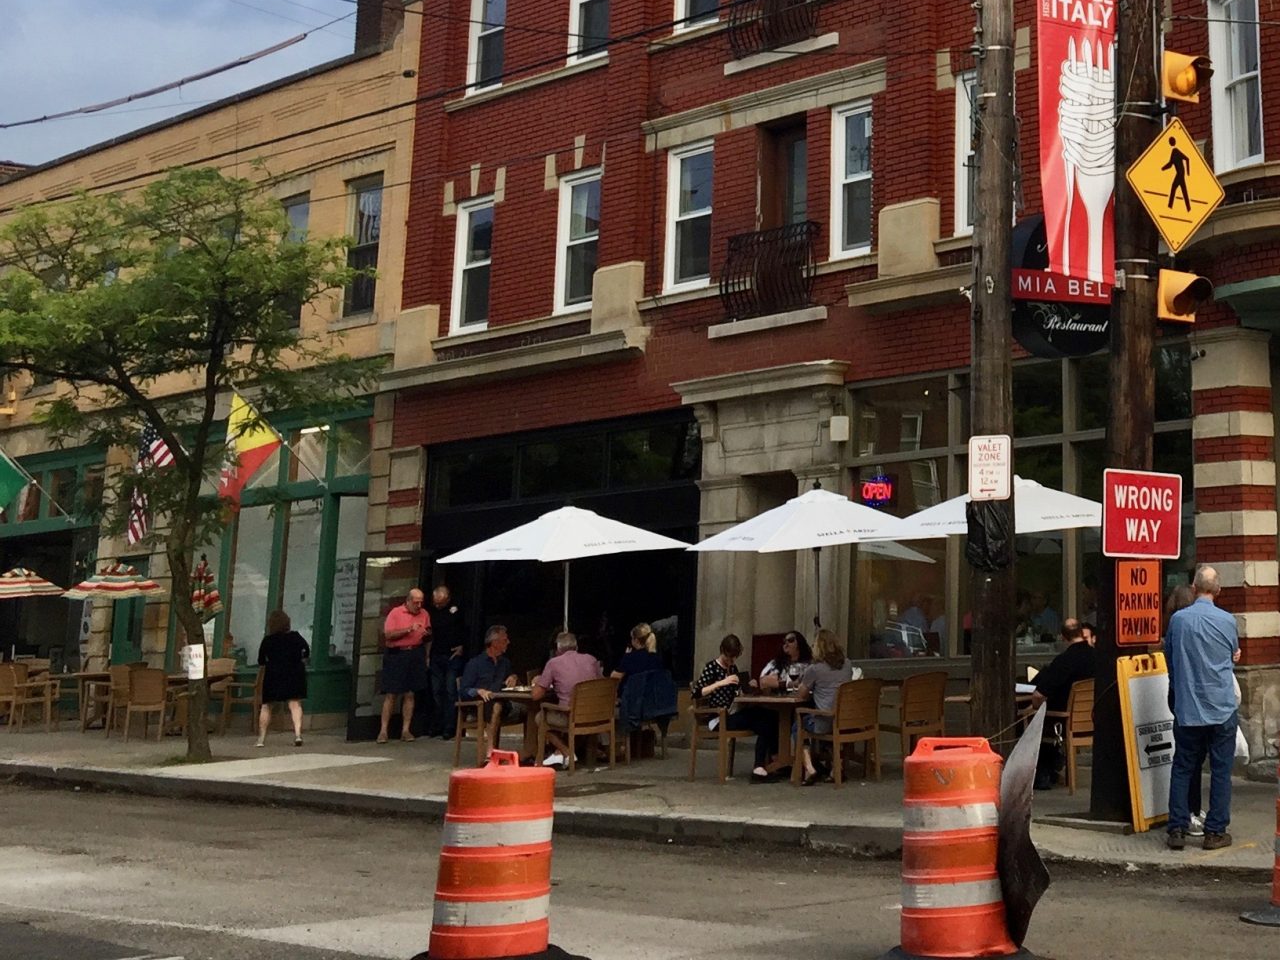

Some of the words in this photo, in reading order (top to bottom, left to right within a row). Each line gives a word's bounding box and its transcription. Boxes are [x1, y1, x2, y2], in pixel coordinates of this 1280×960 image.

[1018, 275, 1056, 294] MIA
[1043, 314, 1109, 333] Restaurant
[977, 442, 1002, 452] VALET
[978, 452, 1001, 461] ZONE
[862, 482, 892, 499] OPEN
[1114, 484, 1173, 512] WRONG
[1125, 518, 1162, 542] WAY
[1130, 567, 1147, 586] NO
[1119, 592, 1159, 611] PARKING
[1122, 616, 1157, 636] PAVING
